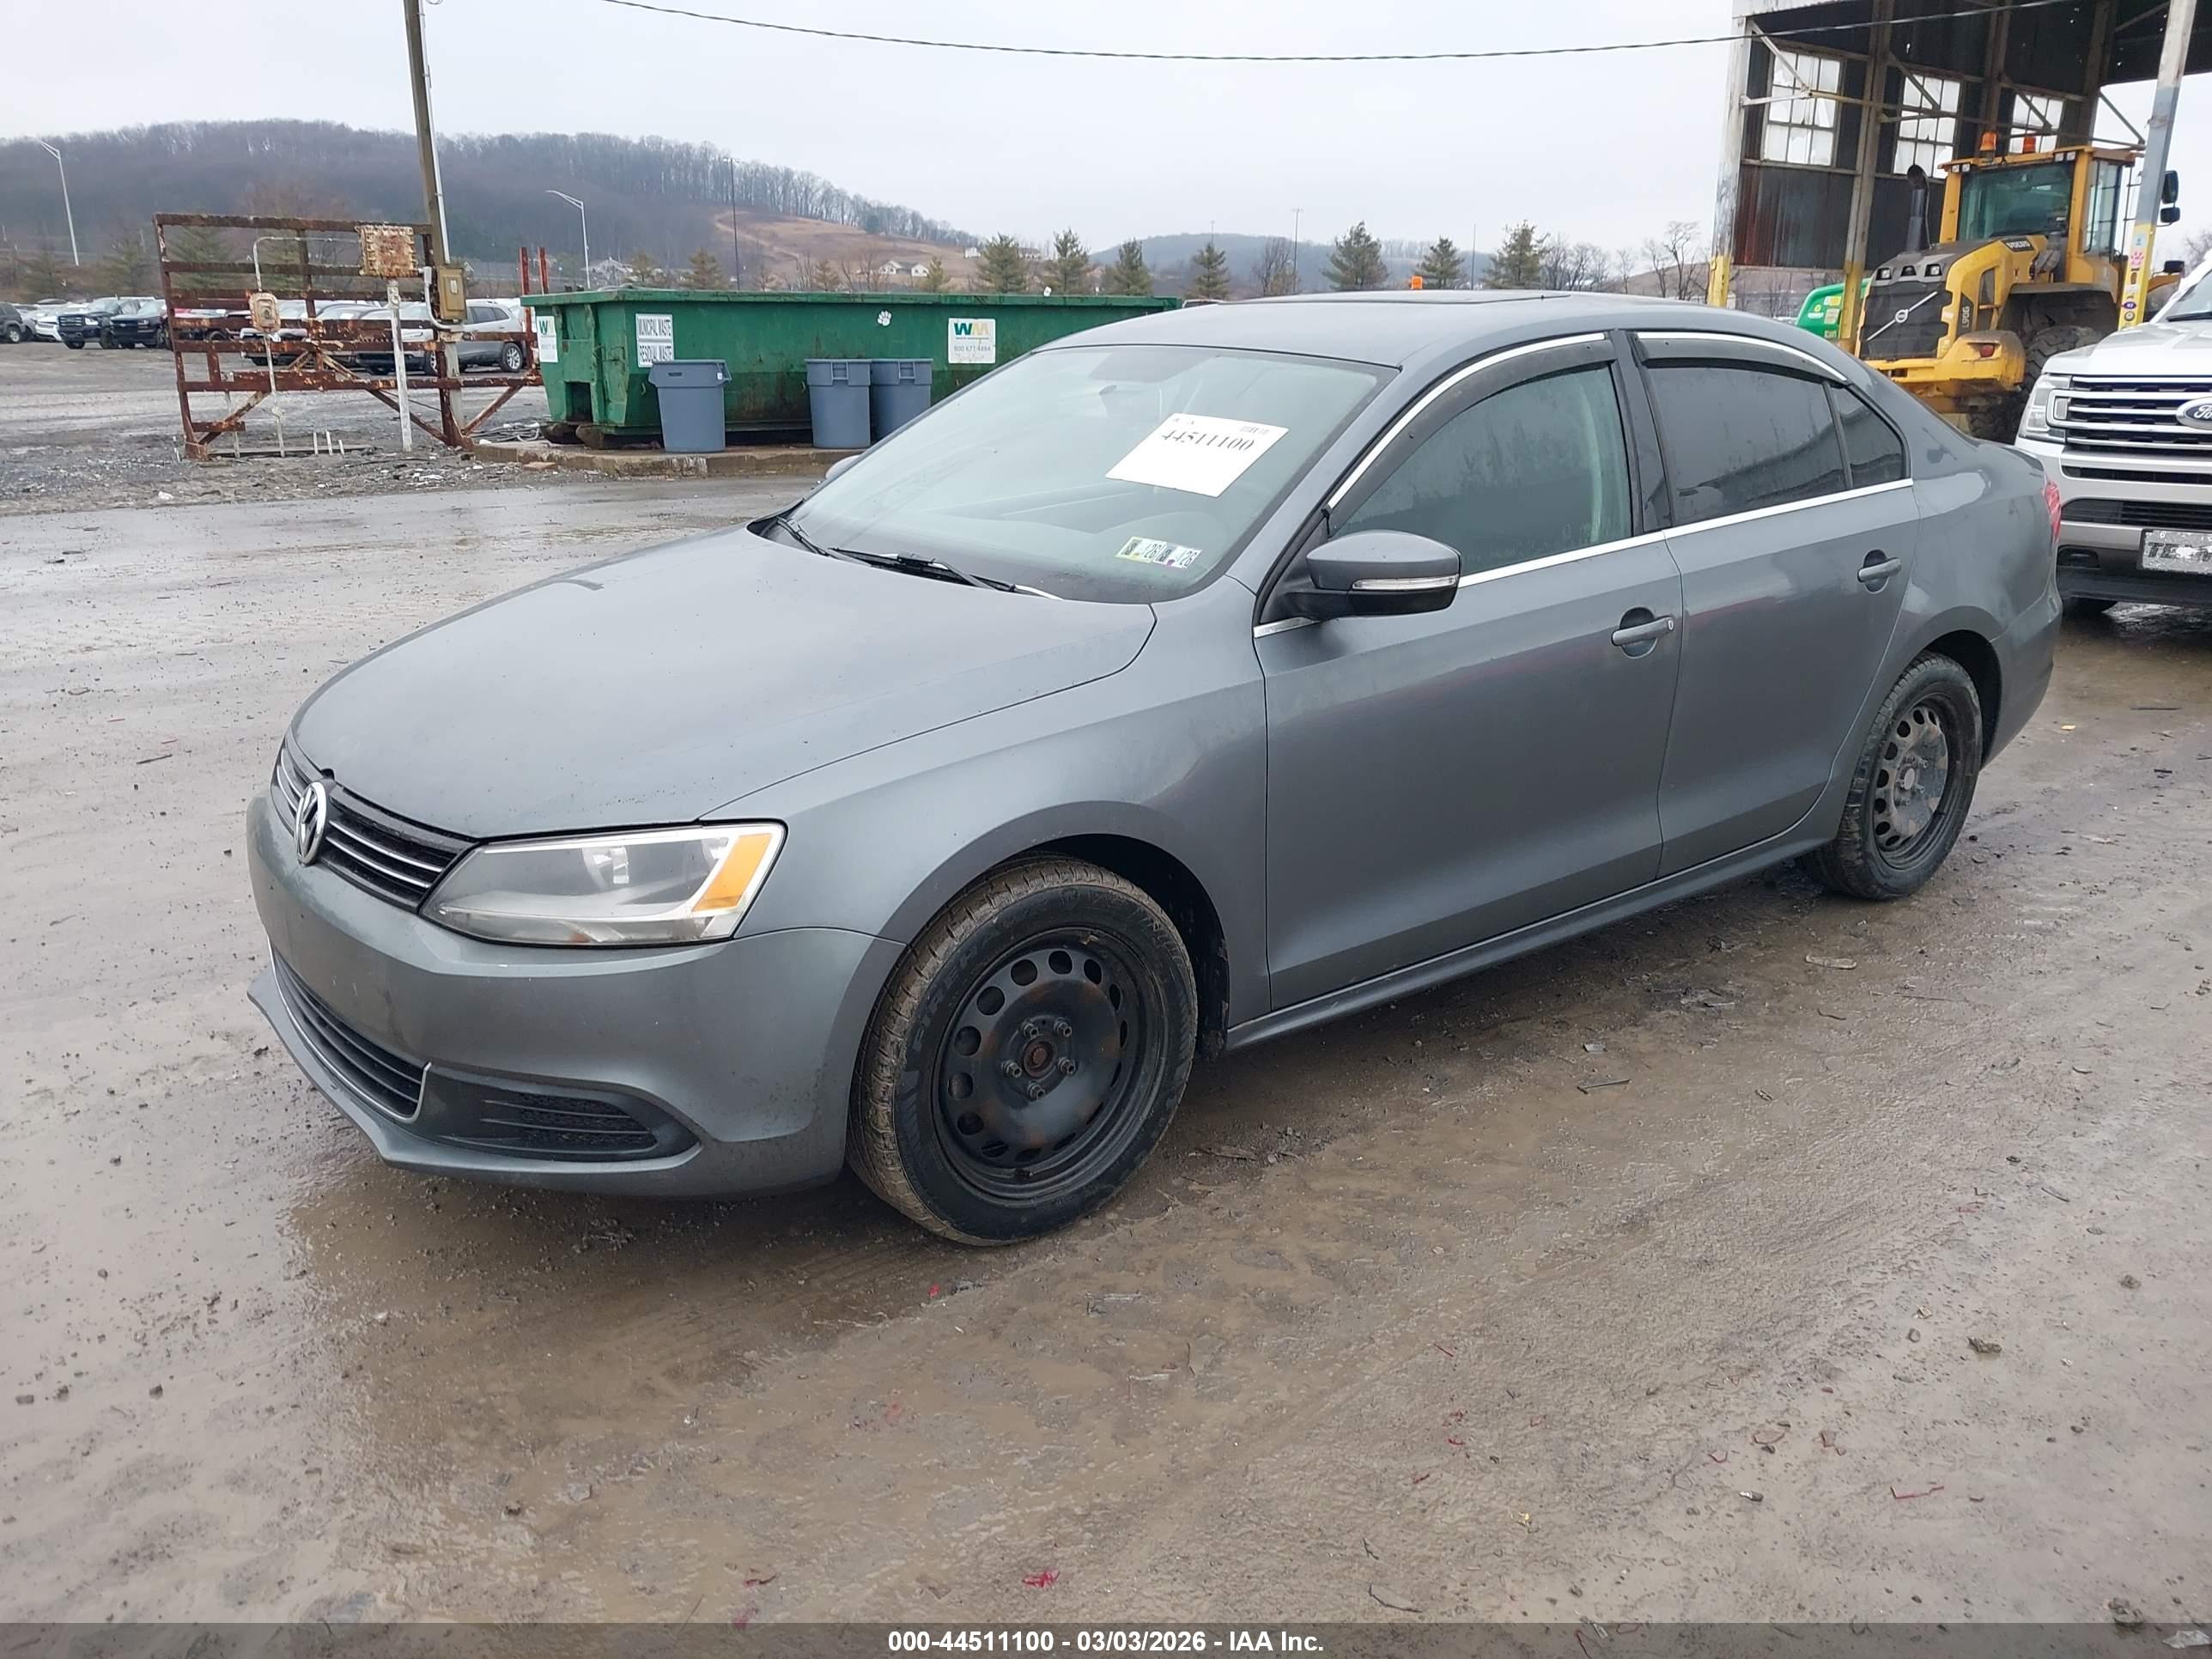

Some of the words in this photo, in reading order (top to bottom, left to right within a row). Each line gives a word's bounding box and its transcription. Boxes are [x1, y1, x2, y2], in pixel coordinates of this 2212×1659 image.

[2006, 240, 2030, 249] VOLVO
[954, 323, 989, 336] WM
[1162, 429, 1255, 452] 44511100
